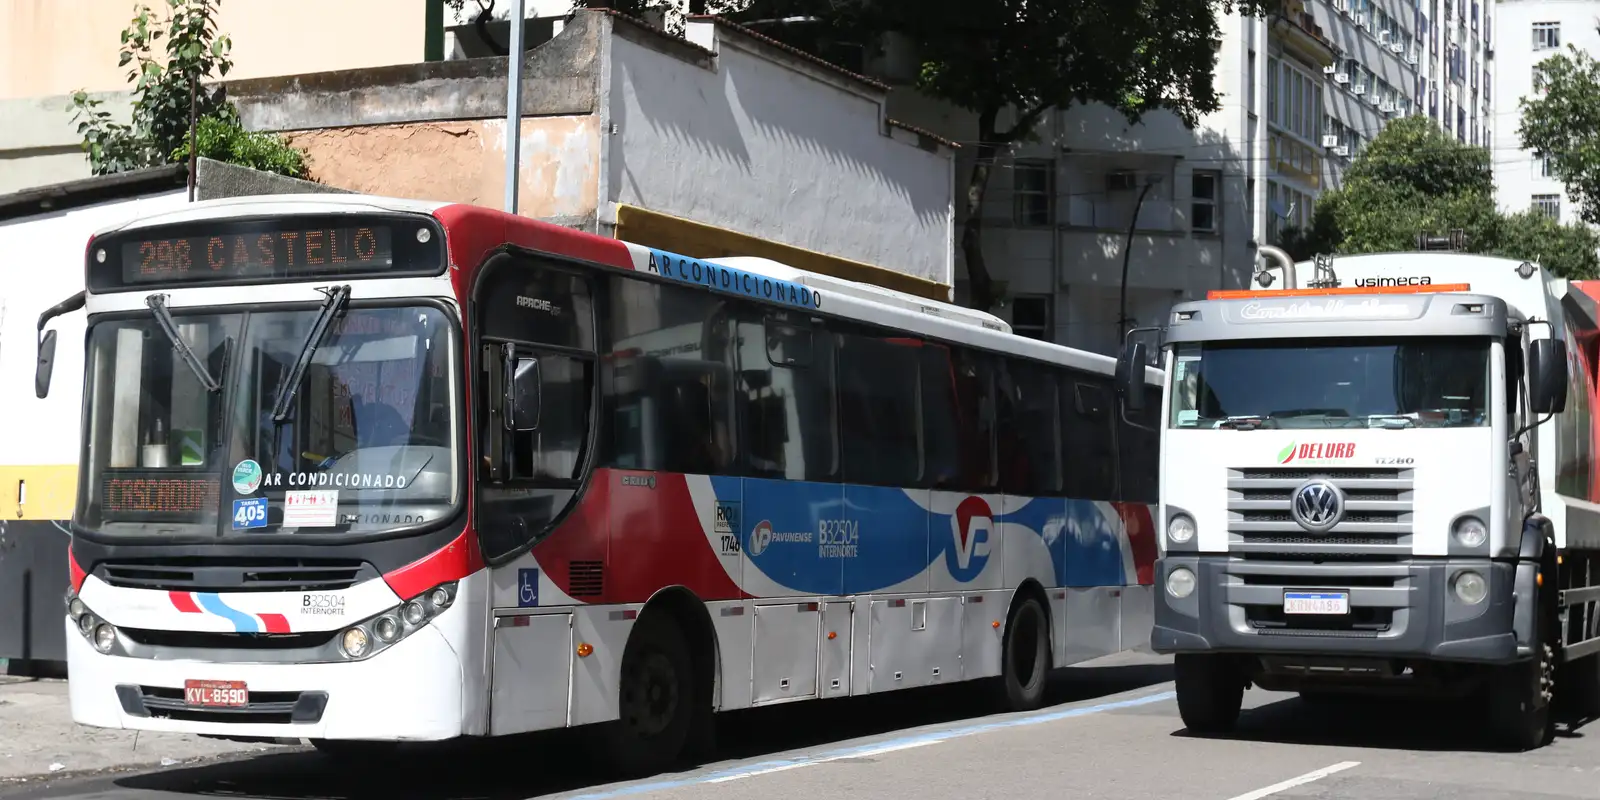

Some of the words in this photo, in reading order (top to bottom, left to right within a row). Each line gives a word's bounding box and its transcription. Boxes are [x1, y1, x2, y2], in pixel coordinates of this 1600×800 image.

[139, 239, 192, 274] 298
[207, 228, 376, 271] CASTELO
[648, 252, 672, 276] AR
[679, 260, 821, 308] CONDICIONADO
[516, 295, 551, 311] APACHE
[1298, 442, 1356, 459] DELURB
[264, 473, 282, 486] AR
[289, 472, 406, 488] CONDICIONADO
[716, 506, 732, 521] RIO
[771, 532, 813, 543] PAVUNENSE
[819, 519, 859, 544] B32504
[721, 535, 740, 552] 1746
[818, 545, 858, 558] INTERNORTE
[303, 594, 345, 608] B32504
[300, 607, 345, 616] INTERNORTE
